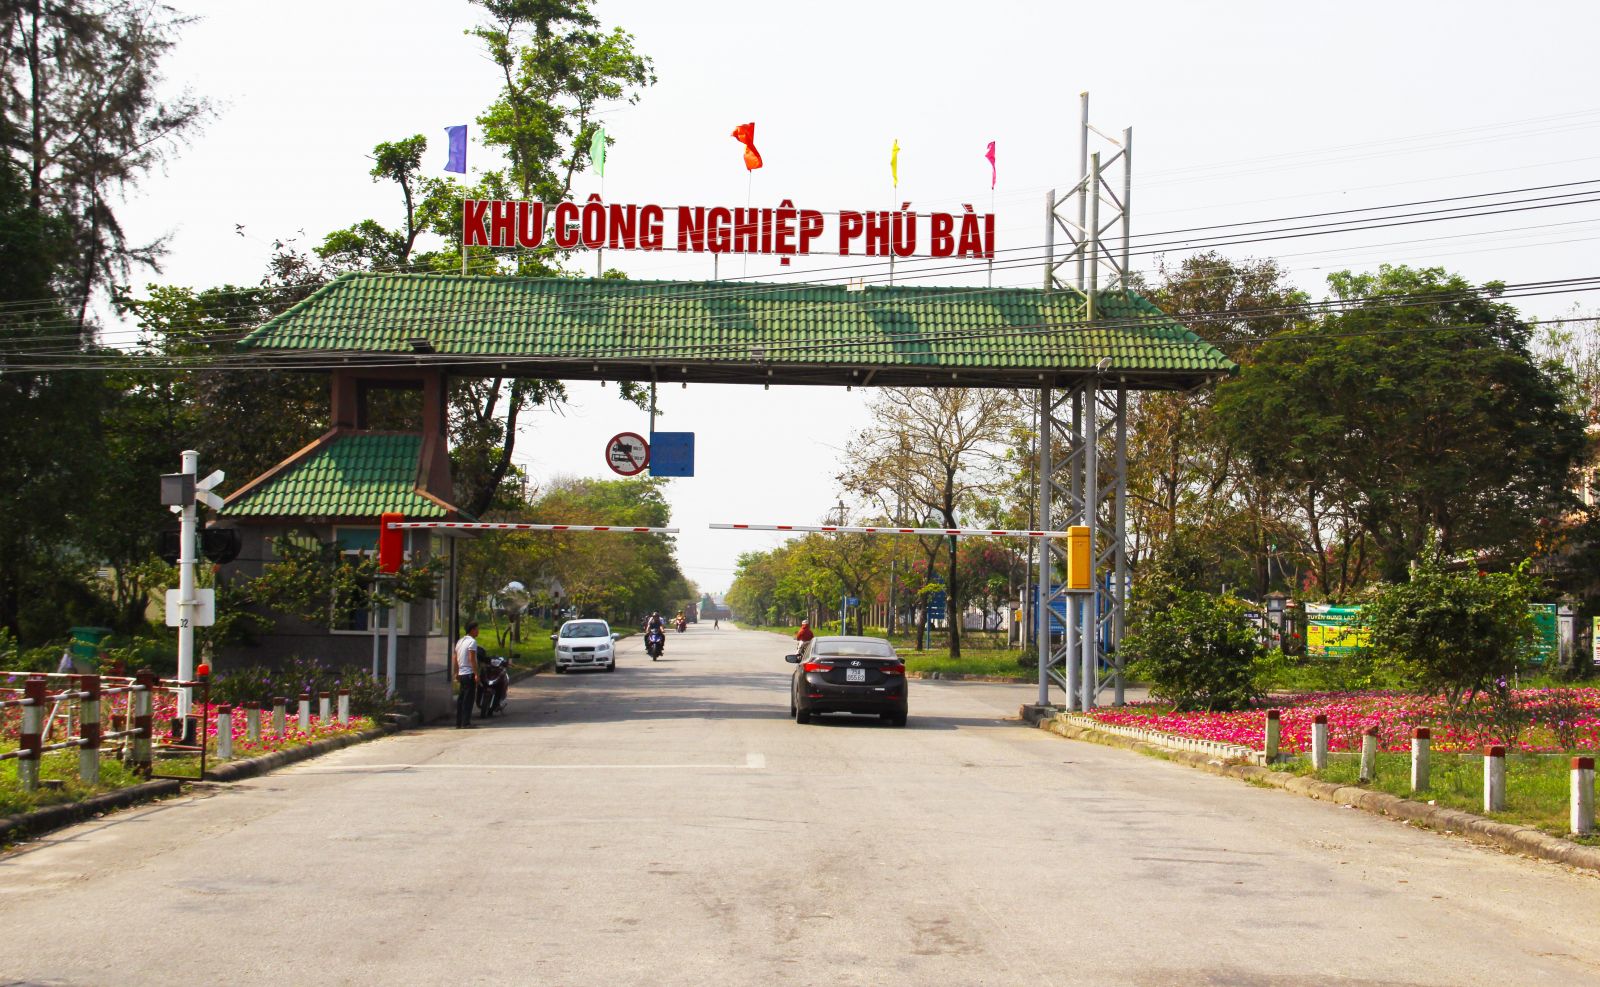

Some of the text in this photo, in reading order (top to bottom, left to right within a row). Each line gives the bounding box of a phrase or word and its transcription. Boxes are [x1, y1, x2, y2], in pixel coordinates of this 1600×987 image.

[463, 193, 995, 266] KHU CÔNG NGHIỆP PHÚ BÀI
